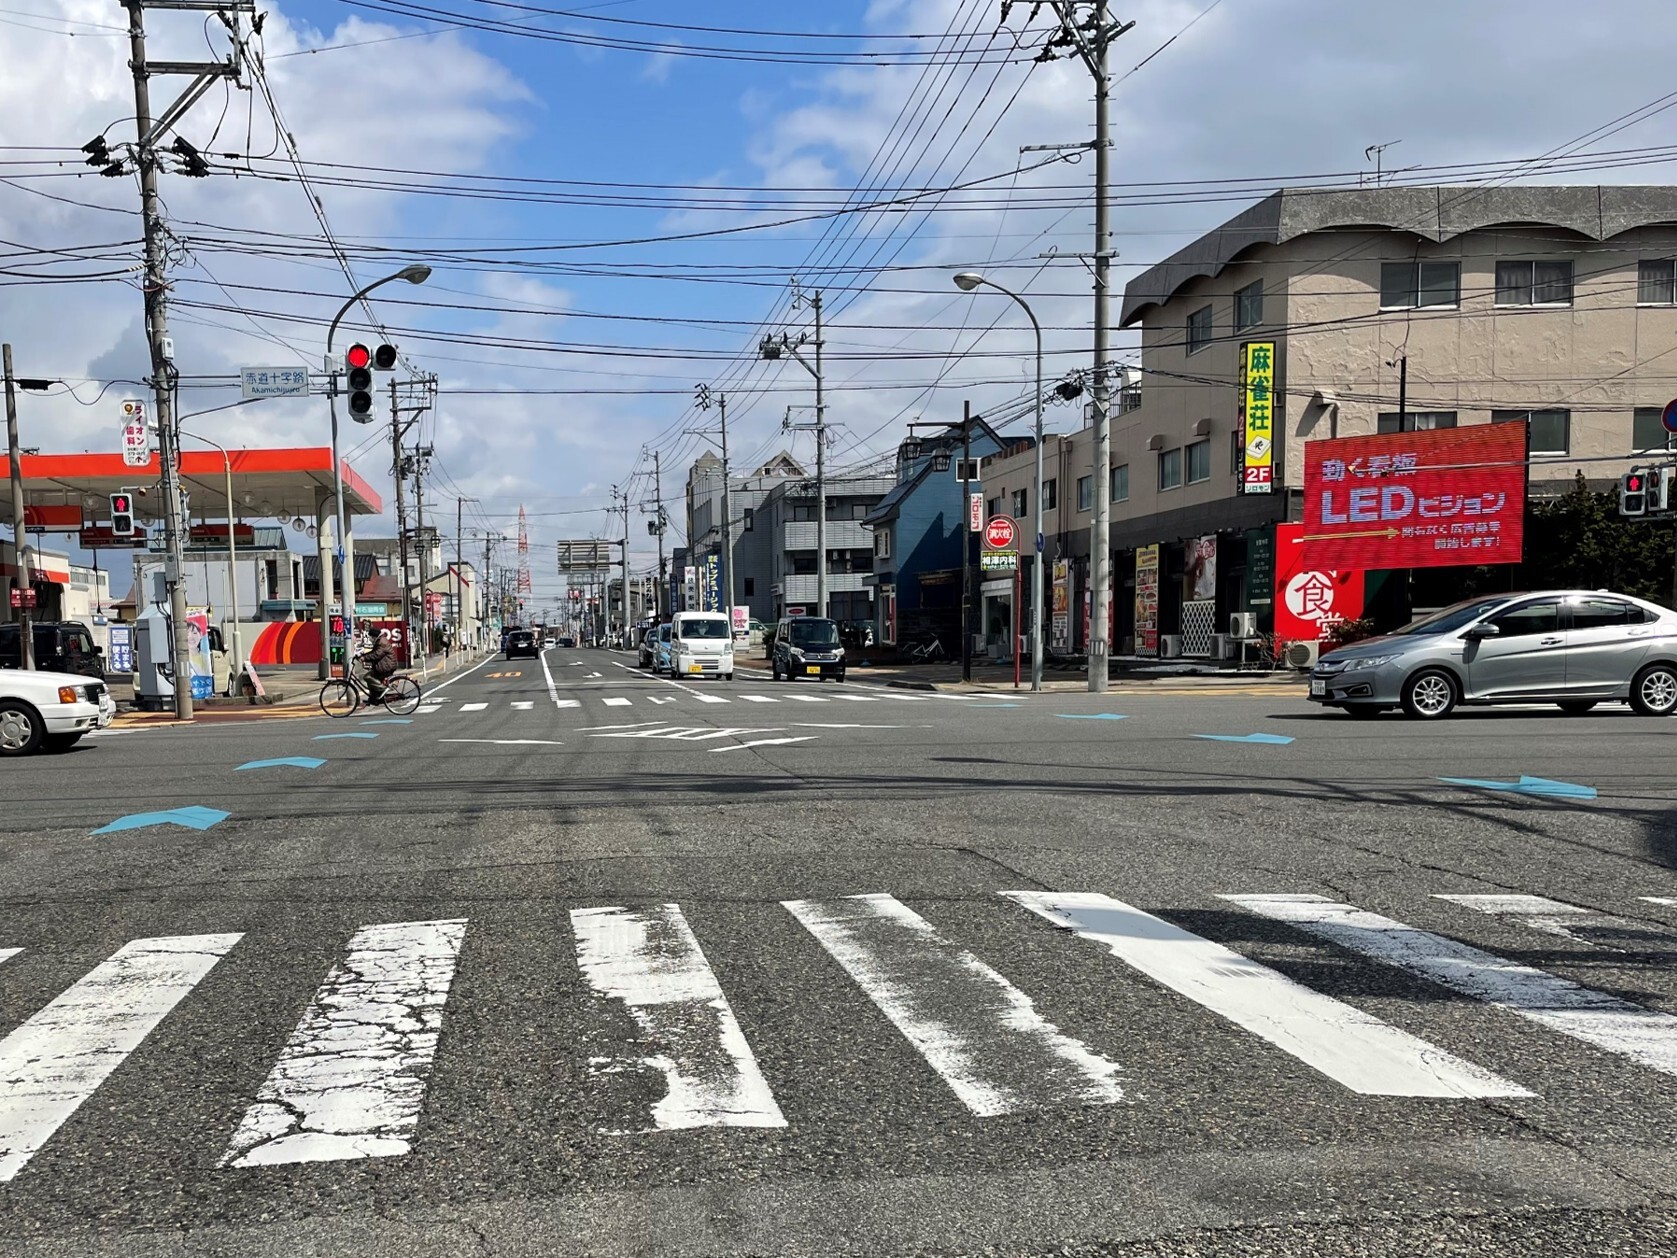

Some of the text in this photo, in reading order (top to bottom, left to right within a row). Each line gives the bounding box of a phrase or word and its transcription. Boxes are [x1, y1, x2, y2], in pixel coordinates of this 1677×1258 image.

[245, 371, 304, 385] 赤道十字路
[1249, 346, 1270, 430] 麻雀荘
[126, 425, 135, 445] 歯科
[134, 405, 145, 446] ライオン
[1246, 468, 1270, 482] 2F
[1321, 452, 1417, 482] 動く看板
[1246, 484, 1269, 492] リロモン
[1321, 485, 1506, 525] LED ビジョン
[988, 528, 1011, 539] 消火栓
